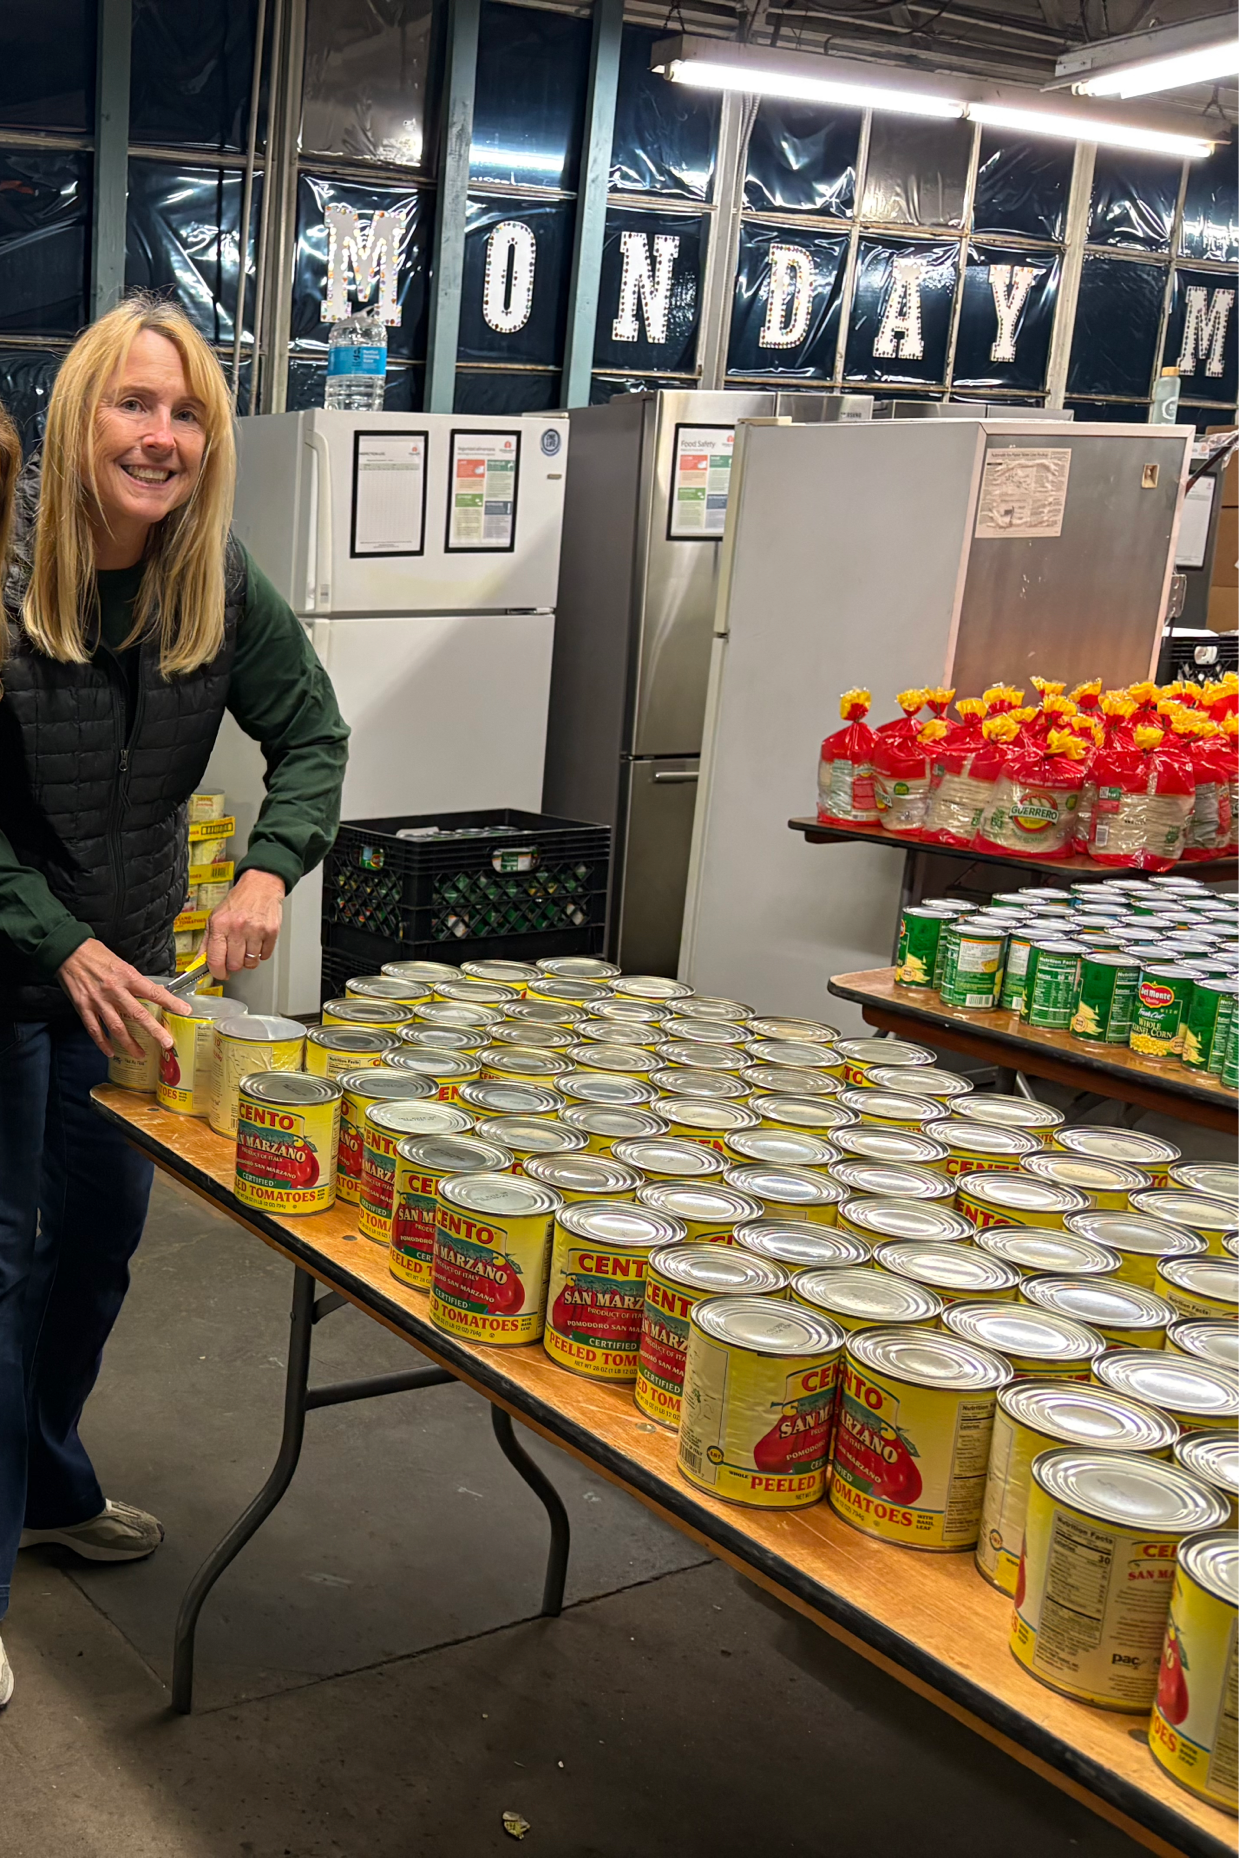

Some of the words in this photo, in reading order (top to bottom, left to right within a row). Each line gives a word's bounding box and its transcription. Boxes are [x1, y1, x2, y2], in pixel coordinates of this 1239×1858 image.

[321, 204, 1035, 364] MONDAY
[681, 440, 696, 448] Food
[697, 440, 715, 449] Safety
[1011, 805, 1058, 820] GUERRERO
[1141, 987, 1149, 997] Del
[1149, 989, 1172, 1000] Monte
[1139, 1017, 1161, 1031] WHOLE
[1151, 1028, 1173, 1039] CORN
[239, 1102, 294, 1130] CENTO
[245, 1135, 307, 1163] MARZANO
[364, 1127, 396, 1157] ENT
[242, 1172, 274, 1187] CERTIFIED
[266, 1166, 296, 1180] MARZANO
[250, 1184, 316, 1203] TOMATOES
[398, 1207, 419, 1222] SAN
[436, 1205, 495, 1245] CENTO
[436, 1259, 454, 1273] PRODUCT
[463, 1272, 480, 1281] ITALY
[441, 1244, 508, 1285] MARZANO
[578, 1252, 648, 1278] CENT
[435, 1288, 468, 1309] CERTIFIED
[447, 1278, 459, 1288] SAN
[460, 1284, 495, 1303] MARZANO
[564, 1290, 592, 1305] SAN
[646, 1281, 693, 1319] CENT
[441, 1303, 519, 1332] TOMATOES
[587, 1307, 619, 1319] PRODUCT
[567, 1320, 610, 1330] POMODORO
[549, 1332, 597, 1362] PEELED
[589, 1338, 637, 1350] CERTIFIED
[666, 1349, 674, 1358] OF
[658, 1358, 671, 1370] SAN
[643, 1369, 680, 1393] CERTIFIED
[962, 1404, 989, 1412] Nutrition
[779, 1413, 814, 1439] SAN
[786, 1440, 827, 1461] POMODORO
[847, 1452, 881, 1483] MARZANO
[750, 1475, 816, 1493] PEELED
[916, 1519, 934, 1527] BASIL
[1090, 1531, 1113, 1545] Facts
[1098, 1554, 1111, 1565] 30
[1128, 1569, 1155, 1581] SAN
